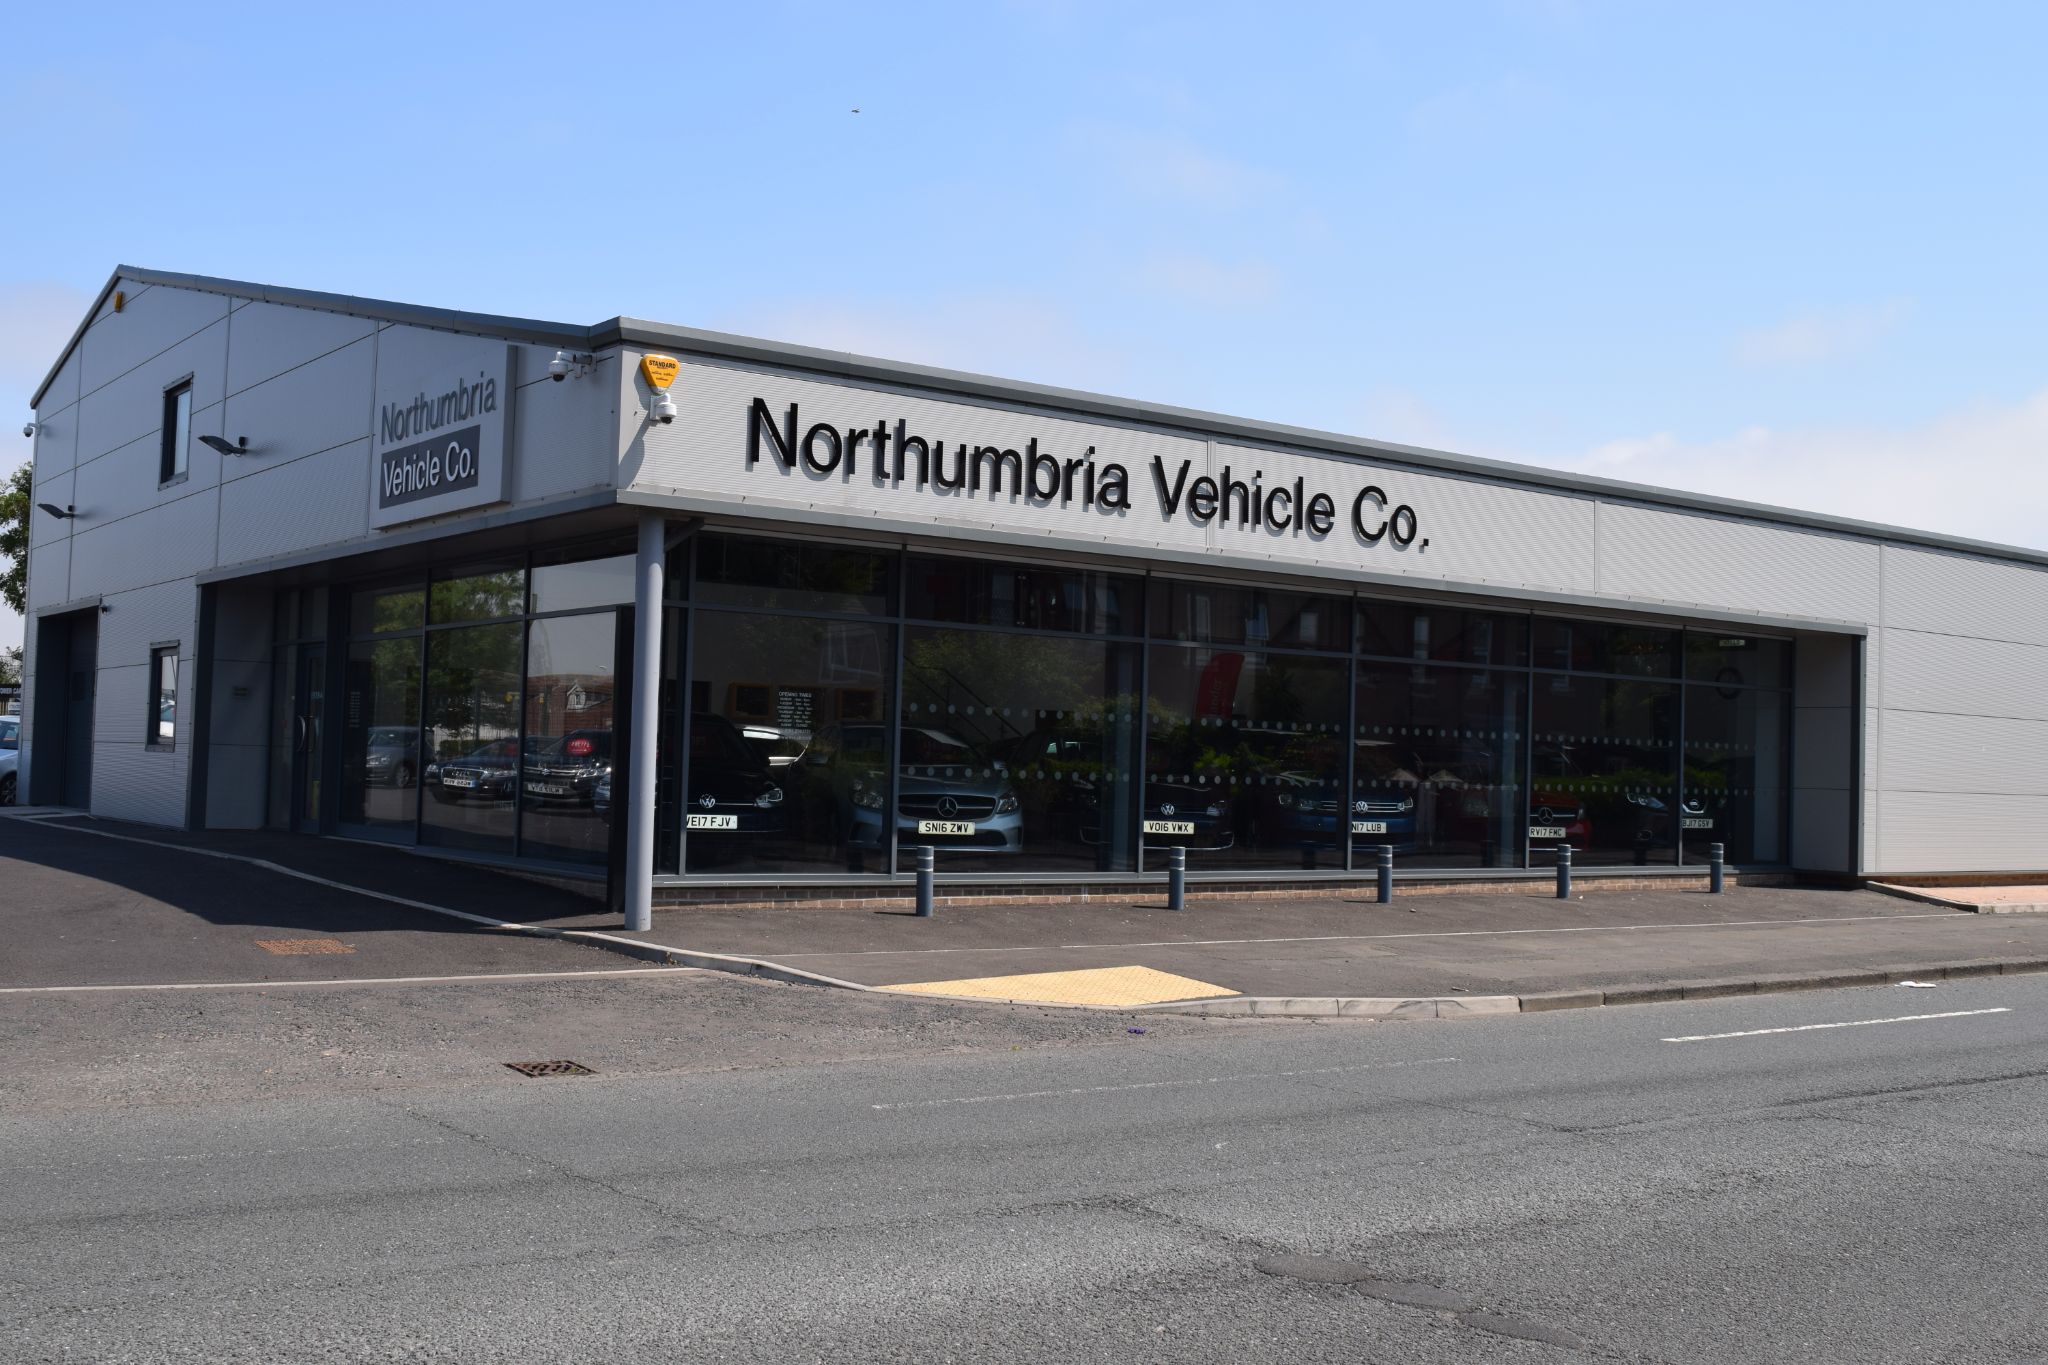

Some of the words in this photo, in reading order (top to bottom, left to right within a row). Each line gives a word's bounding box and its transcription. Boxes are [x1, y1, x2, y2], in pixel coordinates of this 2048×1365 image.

[649, 360, 676, 369] STANDARD
[381, 371, 497, 445] Northumbria
[383, 449, 441, 498] Vehicle
[445, 441, 476, 482] Co.
[746, 397, 1132, 511] Northumbria
[1151, 454, 1336, 537] Vehicle
[1351, 485, 1431, 549] Co.
[710, 816, 731, 828] FJV
[925, 822, 948, 833] SN16
[950, 823, 970, 834] ZWV
[1149, 822, 1169, 832] VO16
[1172, 823, 1189, 833] VWX
[1352, 822, 1364, 832] N17
